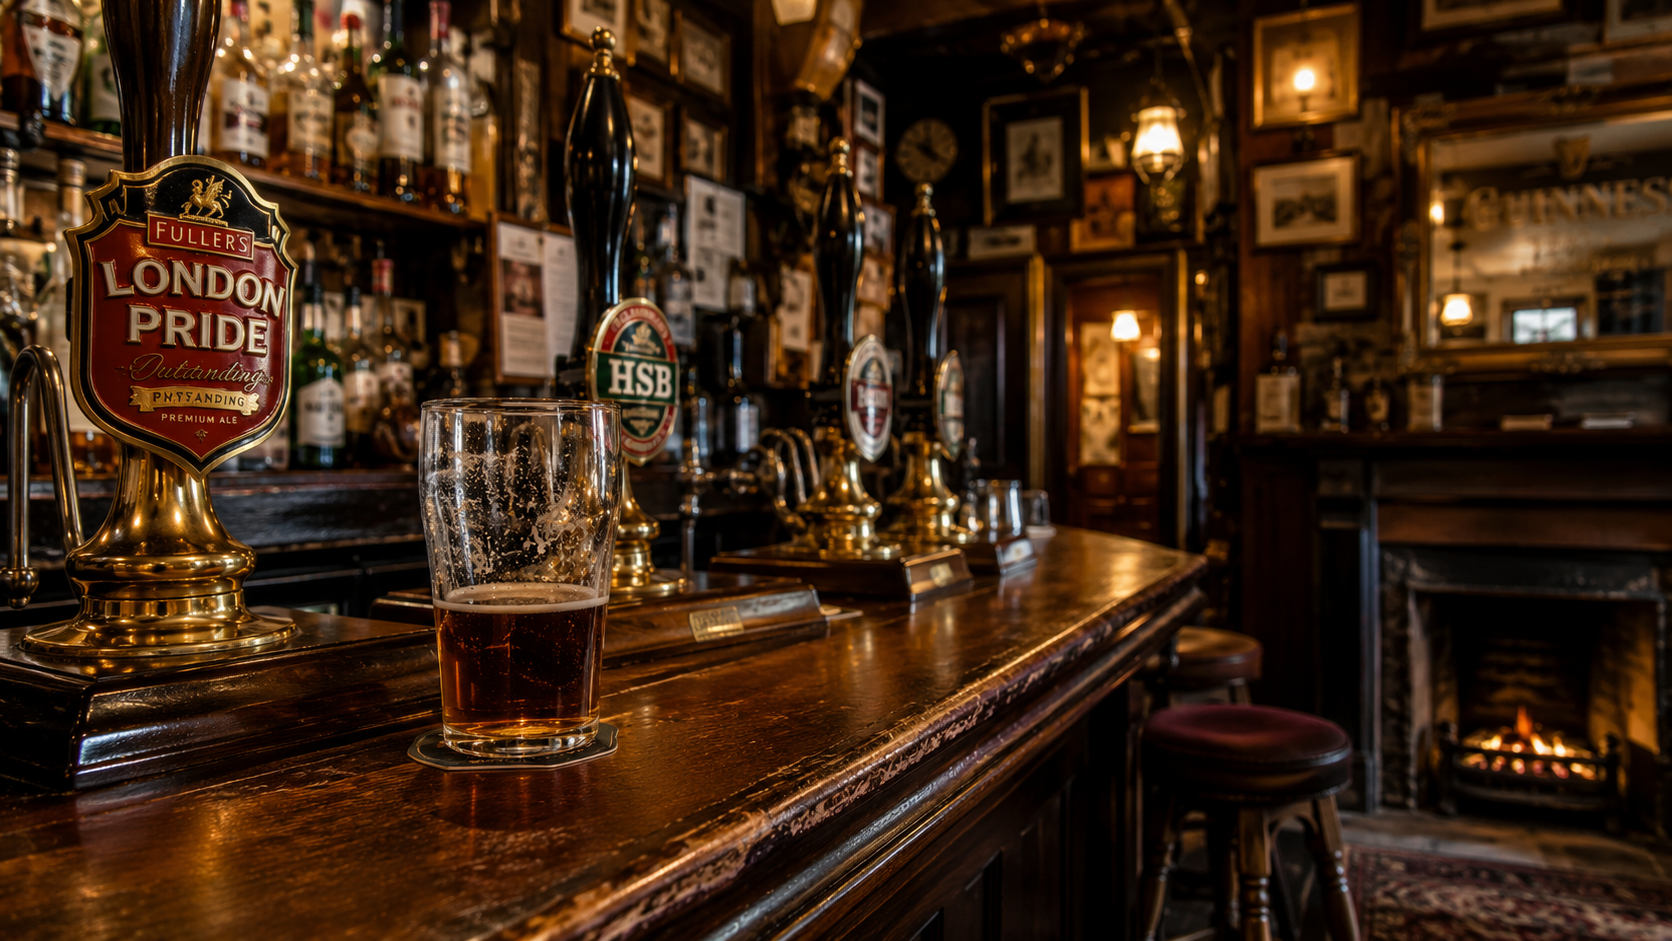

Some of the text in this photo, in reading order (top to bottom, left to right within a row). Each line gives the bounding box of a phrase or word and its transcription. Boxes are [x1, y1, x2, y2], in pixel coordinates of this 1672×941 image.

[1465, 176, 1672, 232] GUINNES
[156, 221, 249, 253] FULLER'S
[100, 258, 286, 318] LONDON
[126, 304, 268, 356] PRIDE
[608, 358, 673, 399] HSB
[161, 413, 238, 425] PREMIUM ALE
